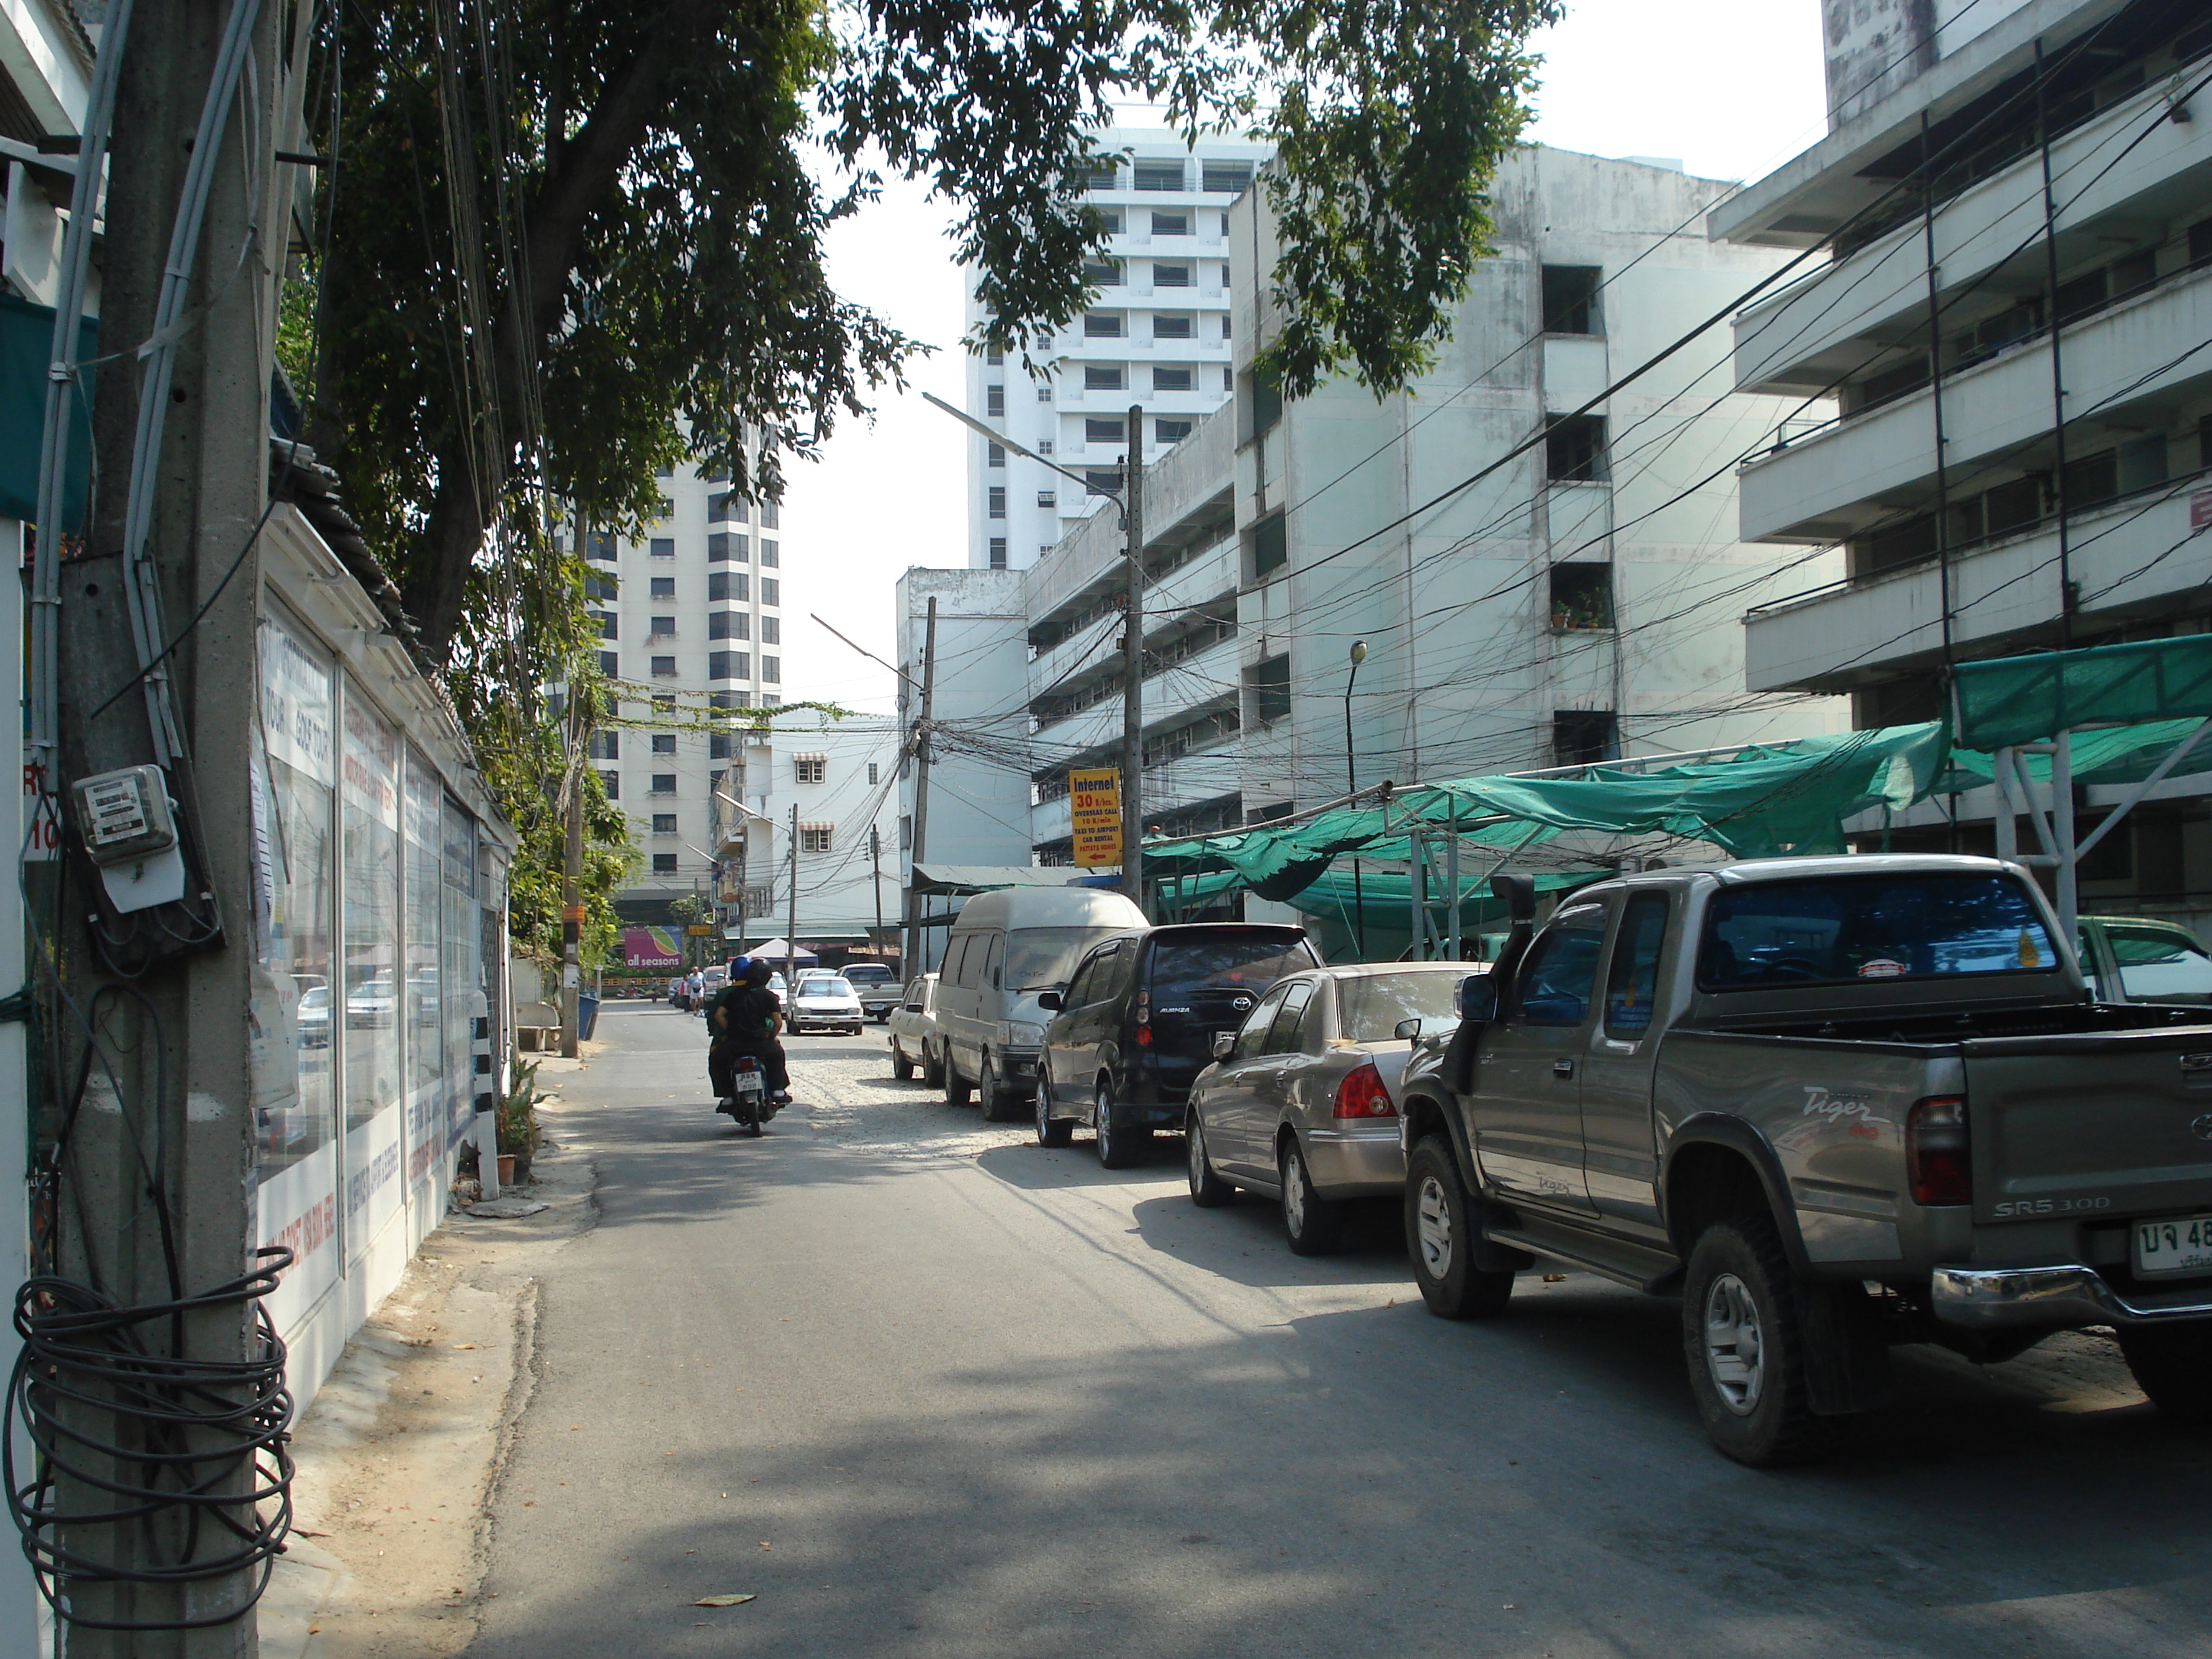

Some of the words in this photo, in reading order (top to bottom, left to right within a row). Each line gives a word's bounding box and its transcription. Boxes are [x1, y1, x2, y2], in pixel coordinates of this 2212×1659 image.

[266, 686, 284, 735] TOUR
[296, 709, 312, 751] GOLF
[313, 722, 328, 764] TOUR
[1074, 776, 1114, 792] Internet
[1077, 794, 1093, 808] 30
[628, 954, 639, 966] all
[1804, 1086, 1892, 1123] Tiger
[1993, 1198, 2053, 1217] SR5
